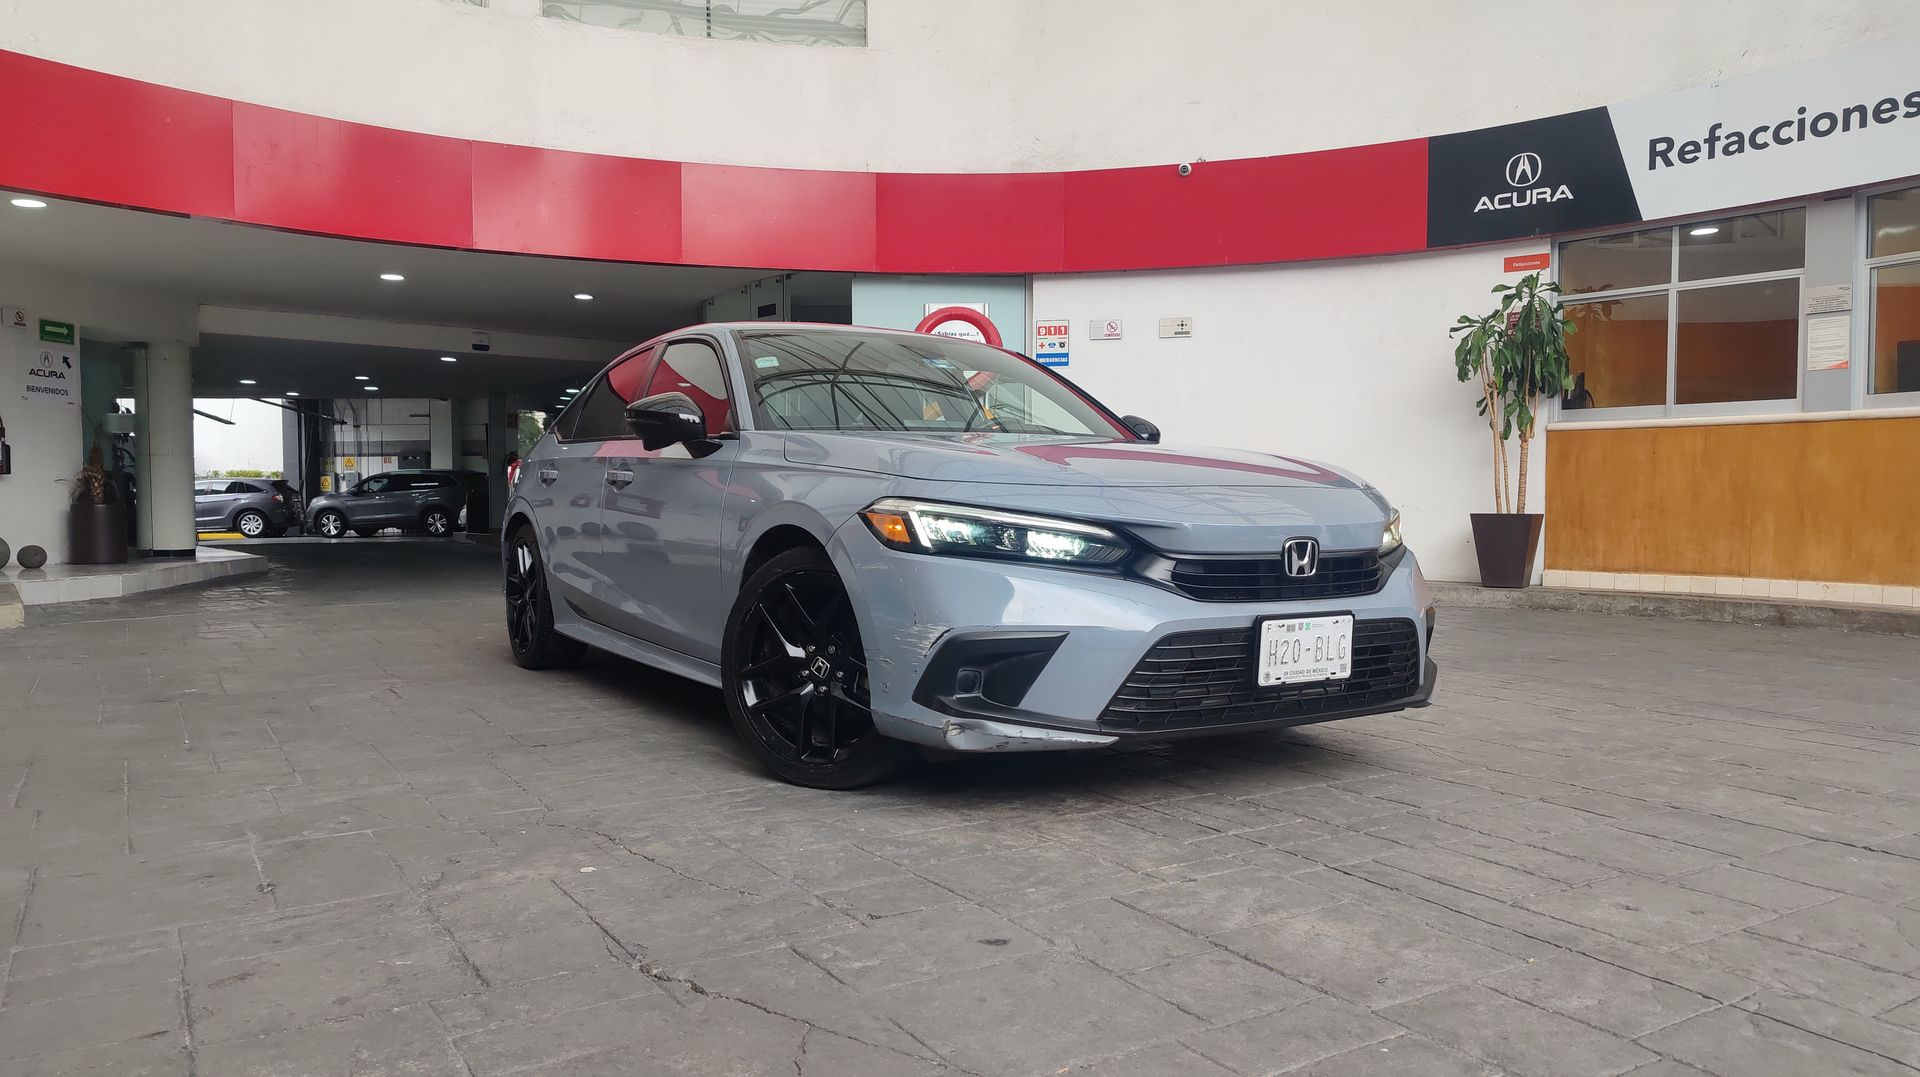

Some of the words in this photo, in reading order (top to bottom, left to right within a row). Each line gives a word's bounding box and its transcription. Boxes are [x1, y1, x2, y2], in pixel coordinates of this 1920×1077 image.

[1648, 89, 1920, 171] Refacciones
[1473, 184, 1574, 212] ACURA
[1039, 326, 1066, 336] 911
[28, 367, 66, 380] ACURA
[26, 384, 69, 396] BIENVENIDOS
